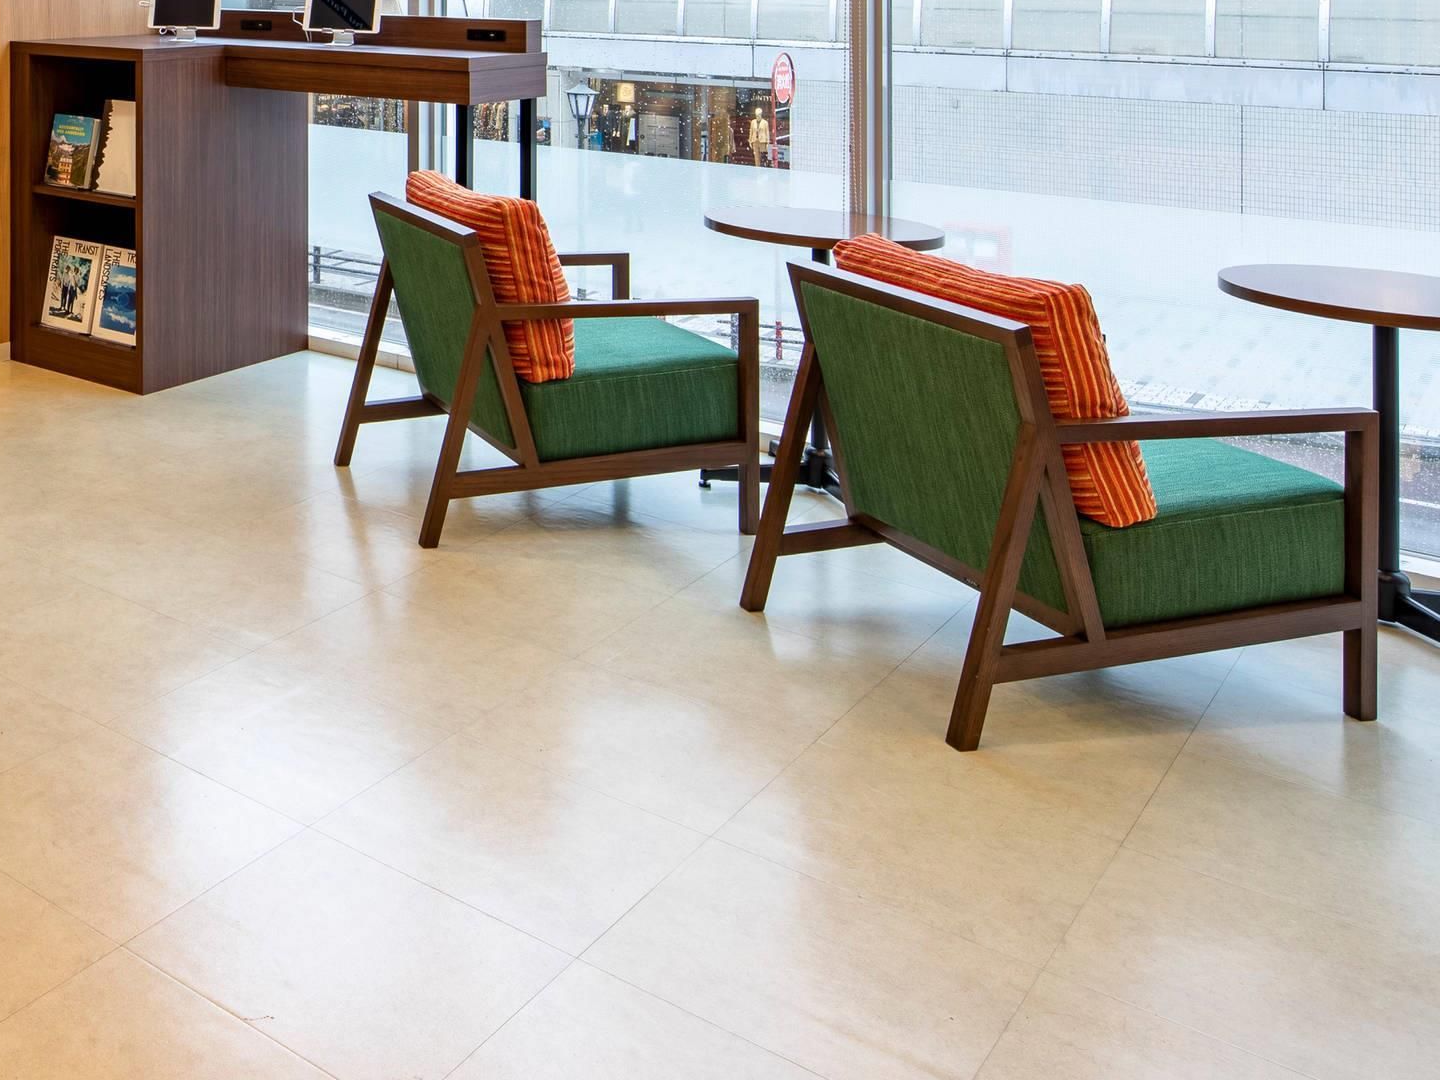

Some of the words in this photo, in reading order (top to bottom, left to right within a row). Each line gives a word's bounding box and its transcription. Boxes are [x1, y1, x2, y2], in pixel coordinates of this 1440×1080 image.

[61, 241, 70, 257] THE
[74, 242, 99, 256] TRANSIT
[49, 238, 63, 282] PORTRAITS
[112, 251, 122, 267] THE
[98, 248, 113, 300] LANDSCAPES
